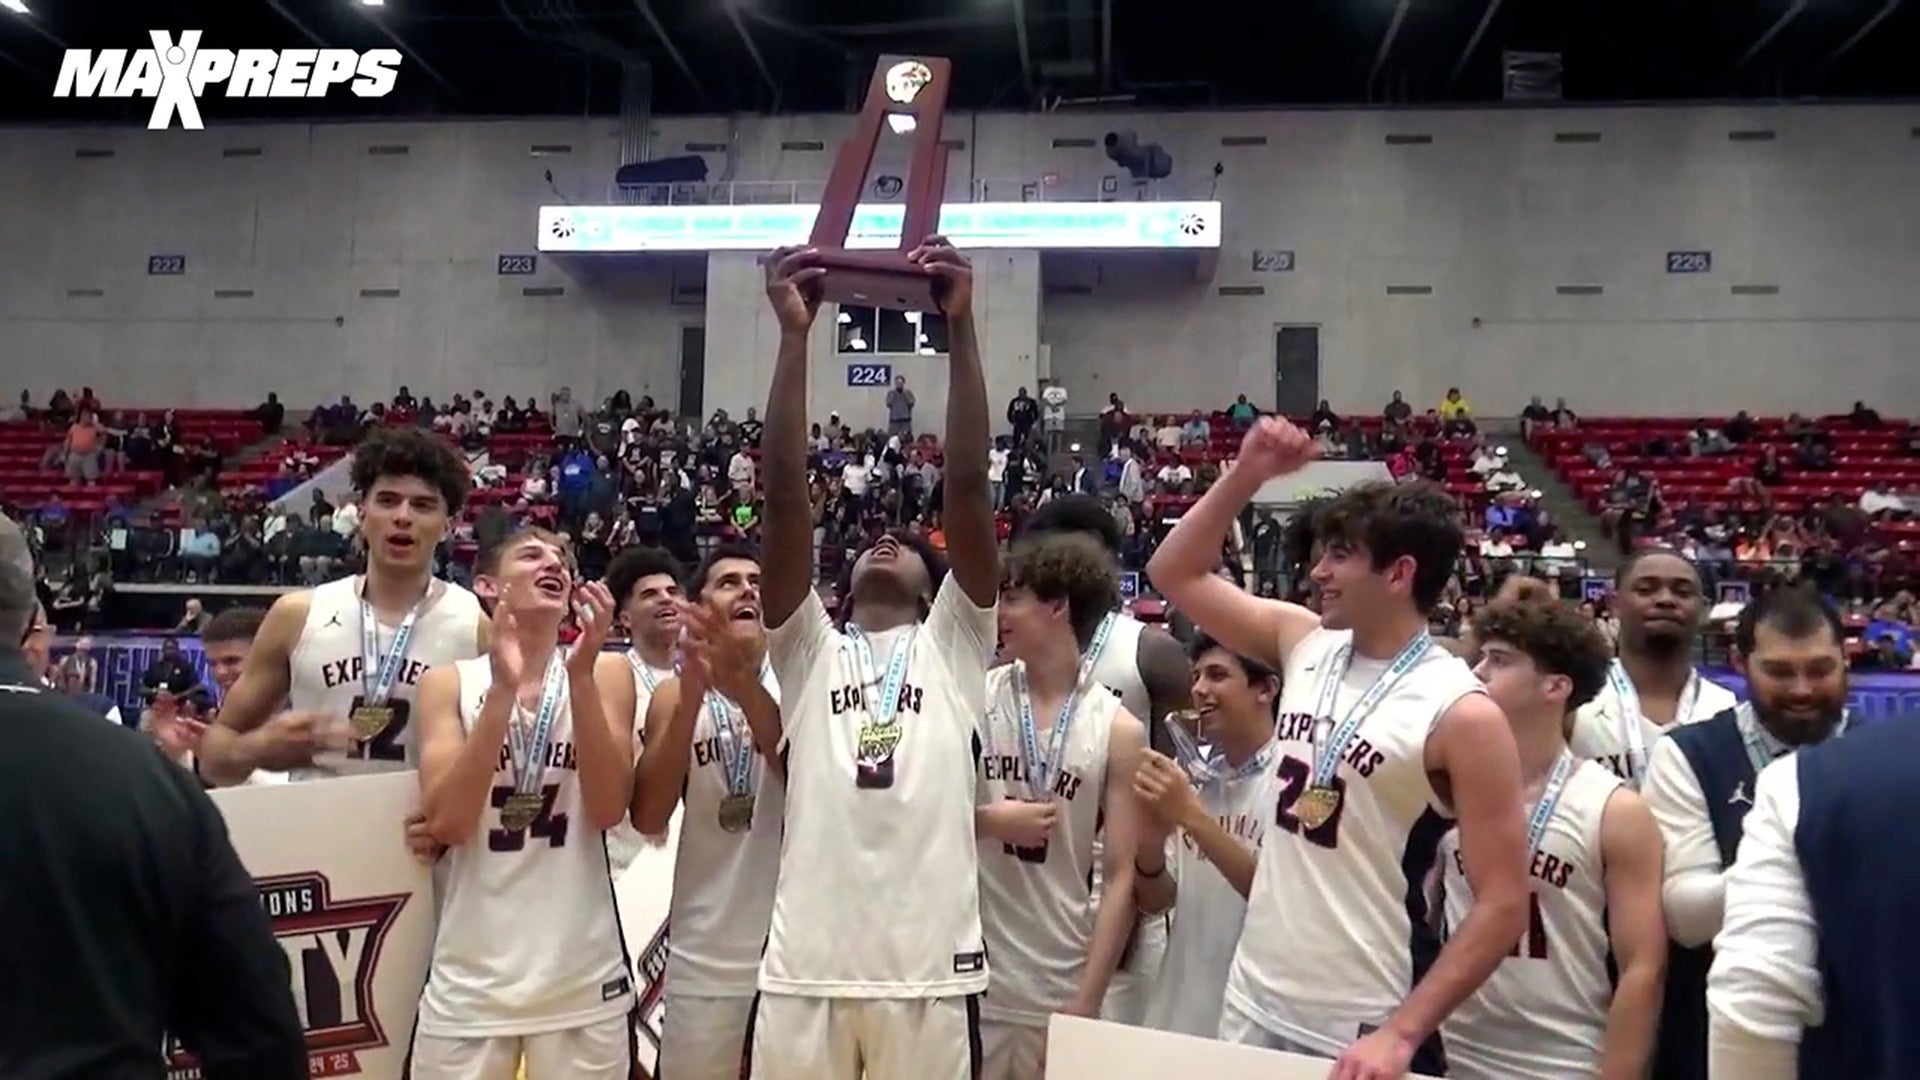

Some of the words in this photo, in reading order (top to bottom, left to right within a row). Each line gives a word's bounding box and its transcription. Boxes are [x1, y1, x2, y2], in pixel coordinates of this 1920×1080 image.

[502, 258, 532, 272] 223
[1671, 255, 1707, 270] 226
[852, 367, 887, 383] 224
[883, 652, 904, 718] BASKETBALL
[532, 696, 553, 764] BASKETBALL
[489, 783, 568, 851] 34
